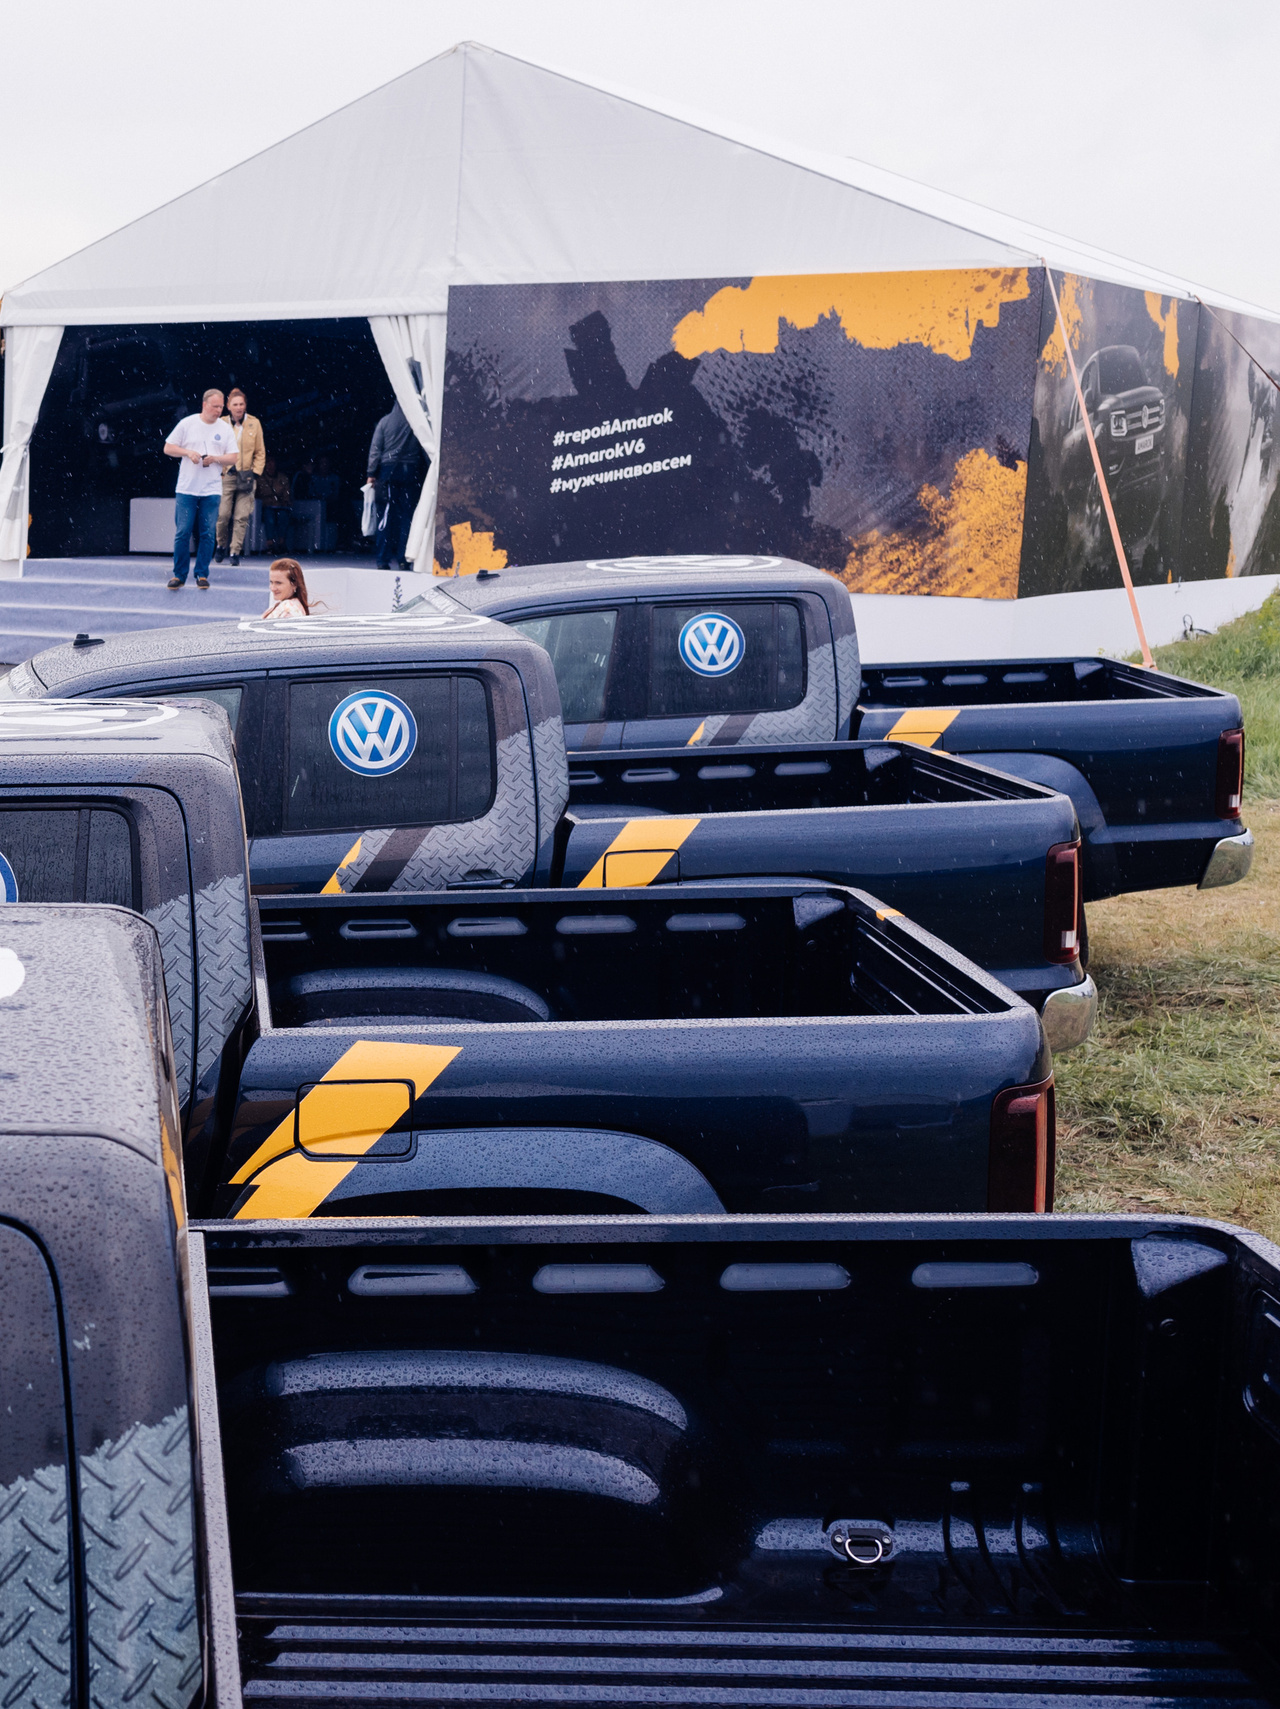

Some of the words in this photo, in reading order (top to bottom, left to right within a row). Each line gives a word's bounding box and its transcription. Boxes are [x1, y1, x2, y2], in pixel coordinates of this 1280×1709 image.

[553, 407, 674, 447] #геройAmarok
[550, 454, 692, 494] #мужчинавовсем
[551, 438, 646, 471] #AmarokV6
[684, 617, 740, 672] VW
[336, 696, 410, 770] VW
